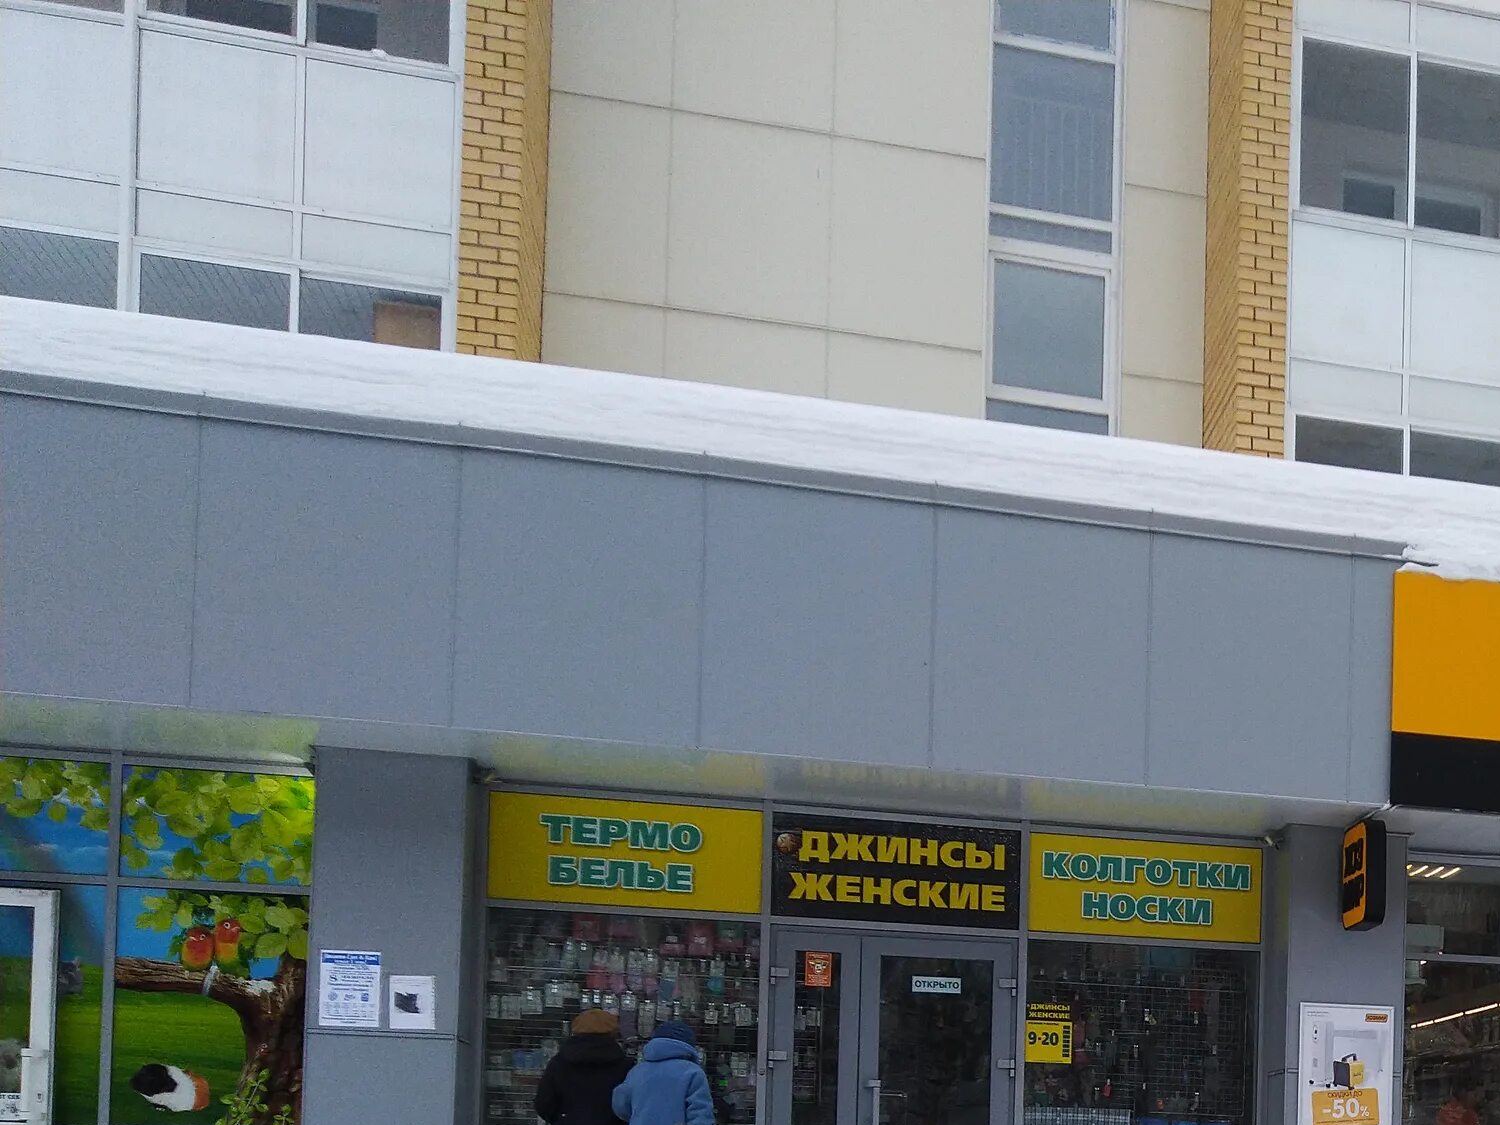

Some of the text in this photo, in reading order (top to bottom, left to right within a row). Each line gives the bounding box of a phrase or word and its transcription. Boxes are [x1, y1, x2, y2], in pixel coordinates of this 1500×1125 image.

[539, 813, 703, 852] ТЕРМО
[798, 830, 1006, 871] ДЖИНСЫ
[547, 855, 694, 893] БЕЛЬЕ
[1042, 851, 1251, 891] КОЛГОТКИ
[788, 872, 1006, 912] ЖЕНСКИЕ
[1082, 891, 1213, 926] НОСКИ
[914, 979, 960, 990] ОТКРЫТО
[1028, 1011, 1071, 1019] ЖЕНСКИЕ
[1030, 1003, 1071, 1011] ДЖИНСЫ
[1322, 1098, 1370, 1119] -50%
